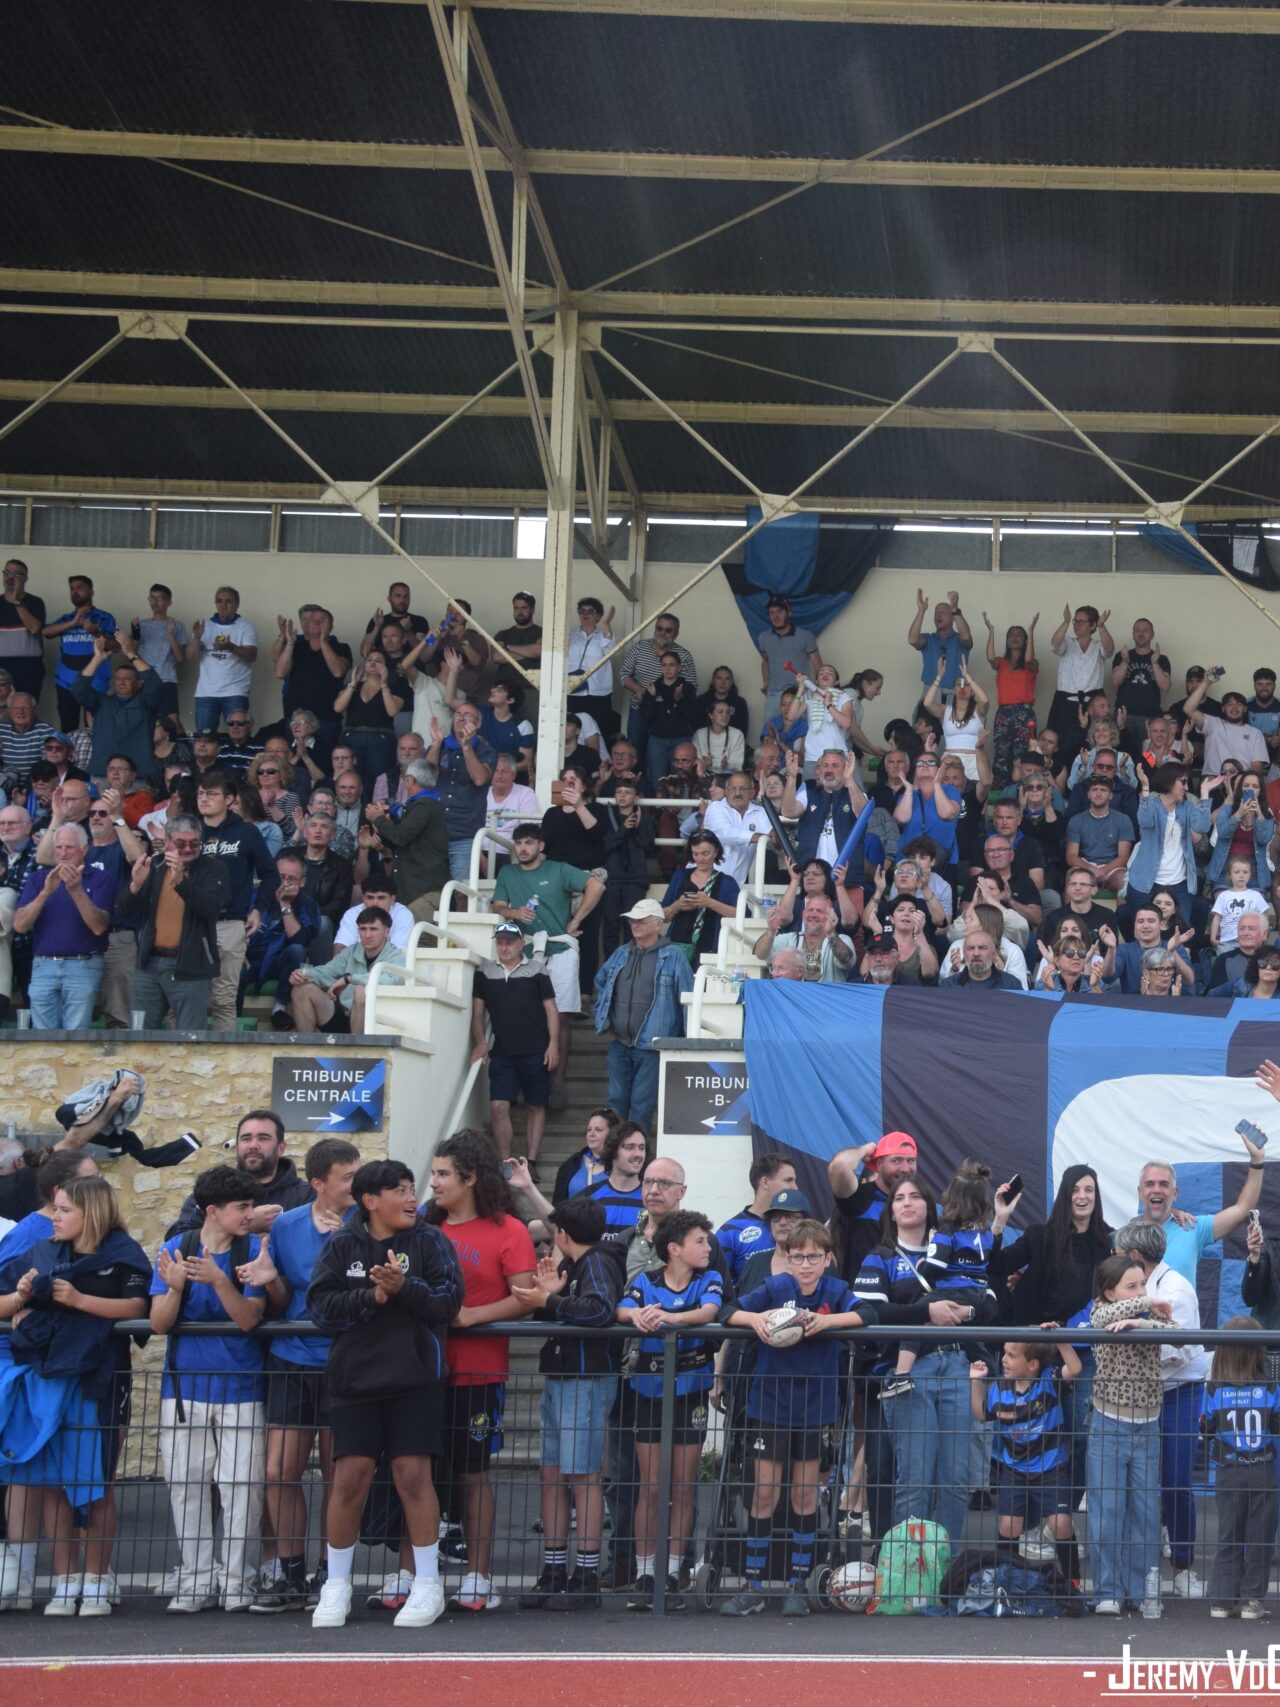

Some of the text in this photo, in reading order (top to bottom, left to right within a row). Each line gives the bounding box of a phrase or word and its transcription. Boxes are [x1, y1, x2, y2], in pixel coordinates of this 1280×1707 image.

[292, 1070, 365, 1084] TRIBUNE
[685, 1076, 751, 1089] TRIBUN
[284, 1089, 371, 1104] CENTRALE
[974, 1233, 985, 1261] 1
[1226, 1409, 1262, 1448] 10
